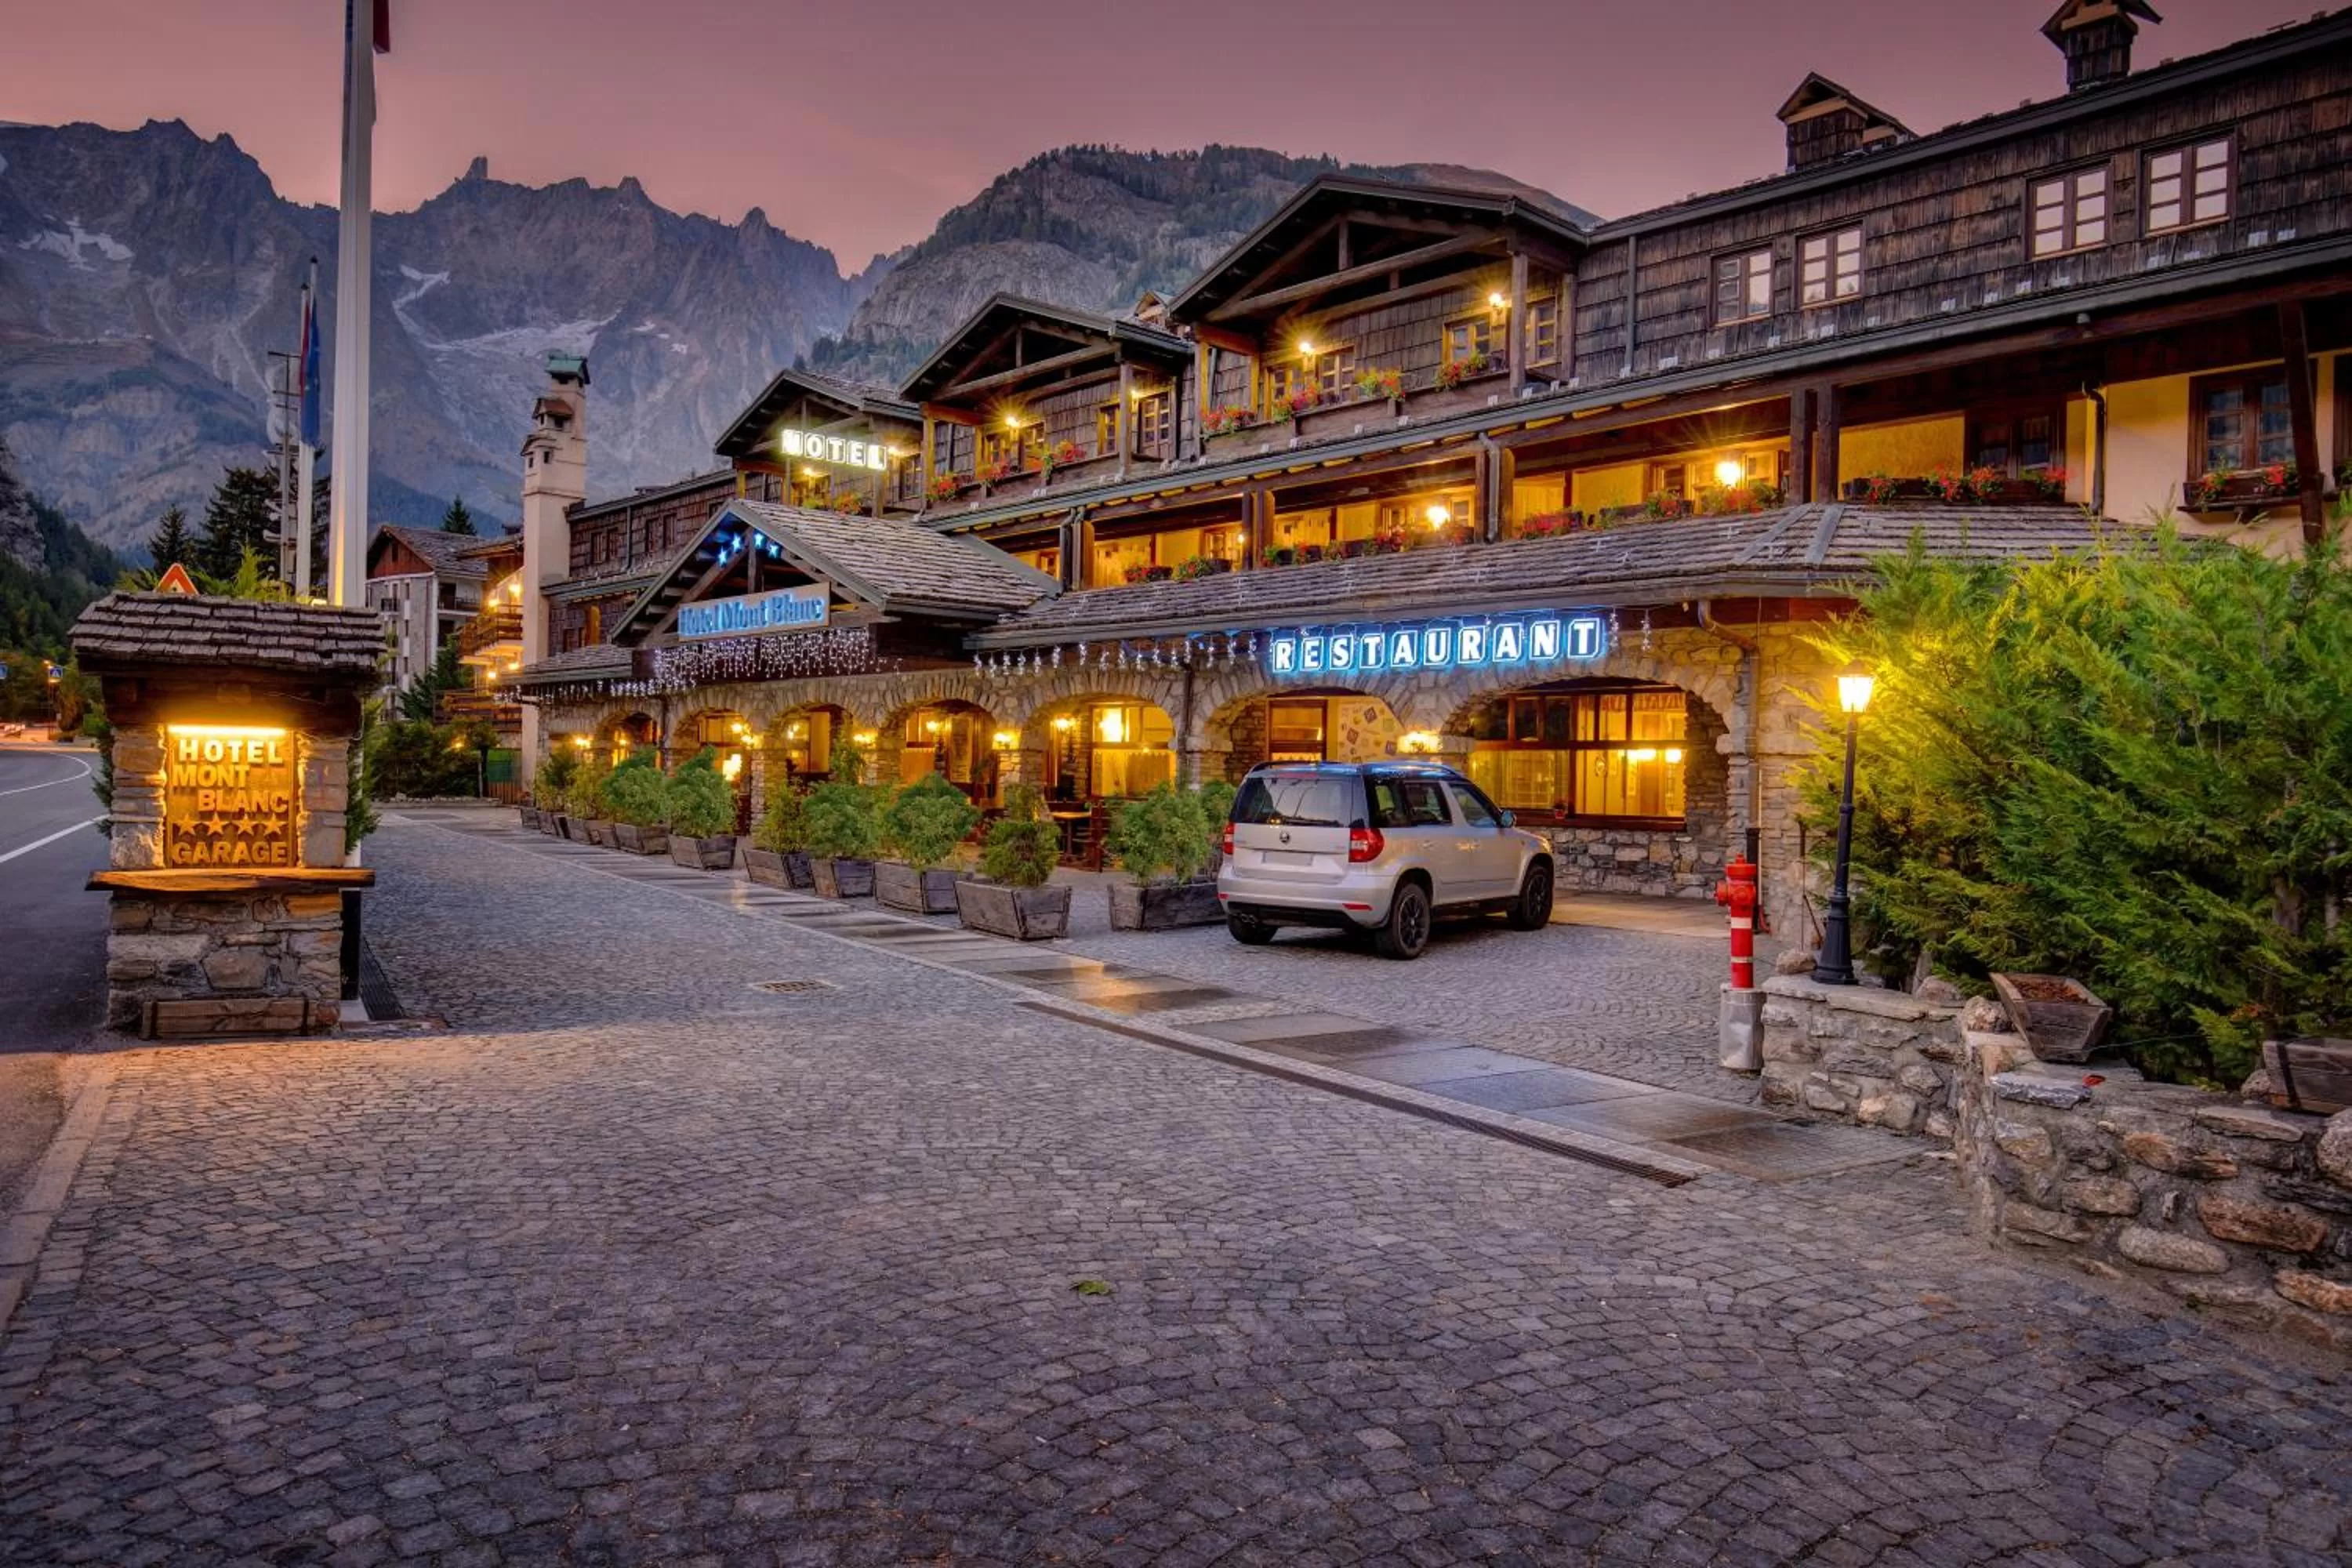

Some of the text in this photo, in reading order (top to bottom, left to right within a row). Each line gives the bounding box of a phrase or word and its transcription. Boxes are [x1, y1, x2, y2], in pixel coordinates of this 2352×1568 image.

[677, 602, 723, 635] Hotel
[723, 599, 769, 630] Mont
[1273, 619, 1599, 671] RESTAURANT
[179, 739, 283, 764] HOTEL
[172, 764, 250, 788] MONT
[198, 789, 289, 813] BLANC
[172, 840, 288, 864] GARAGE
